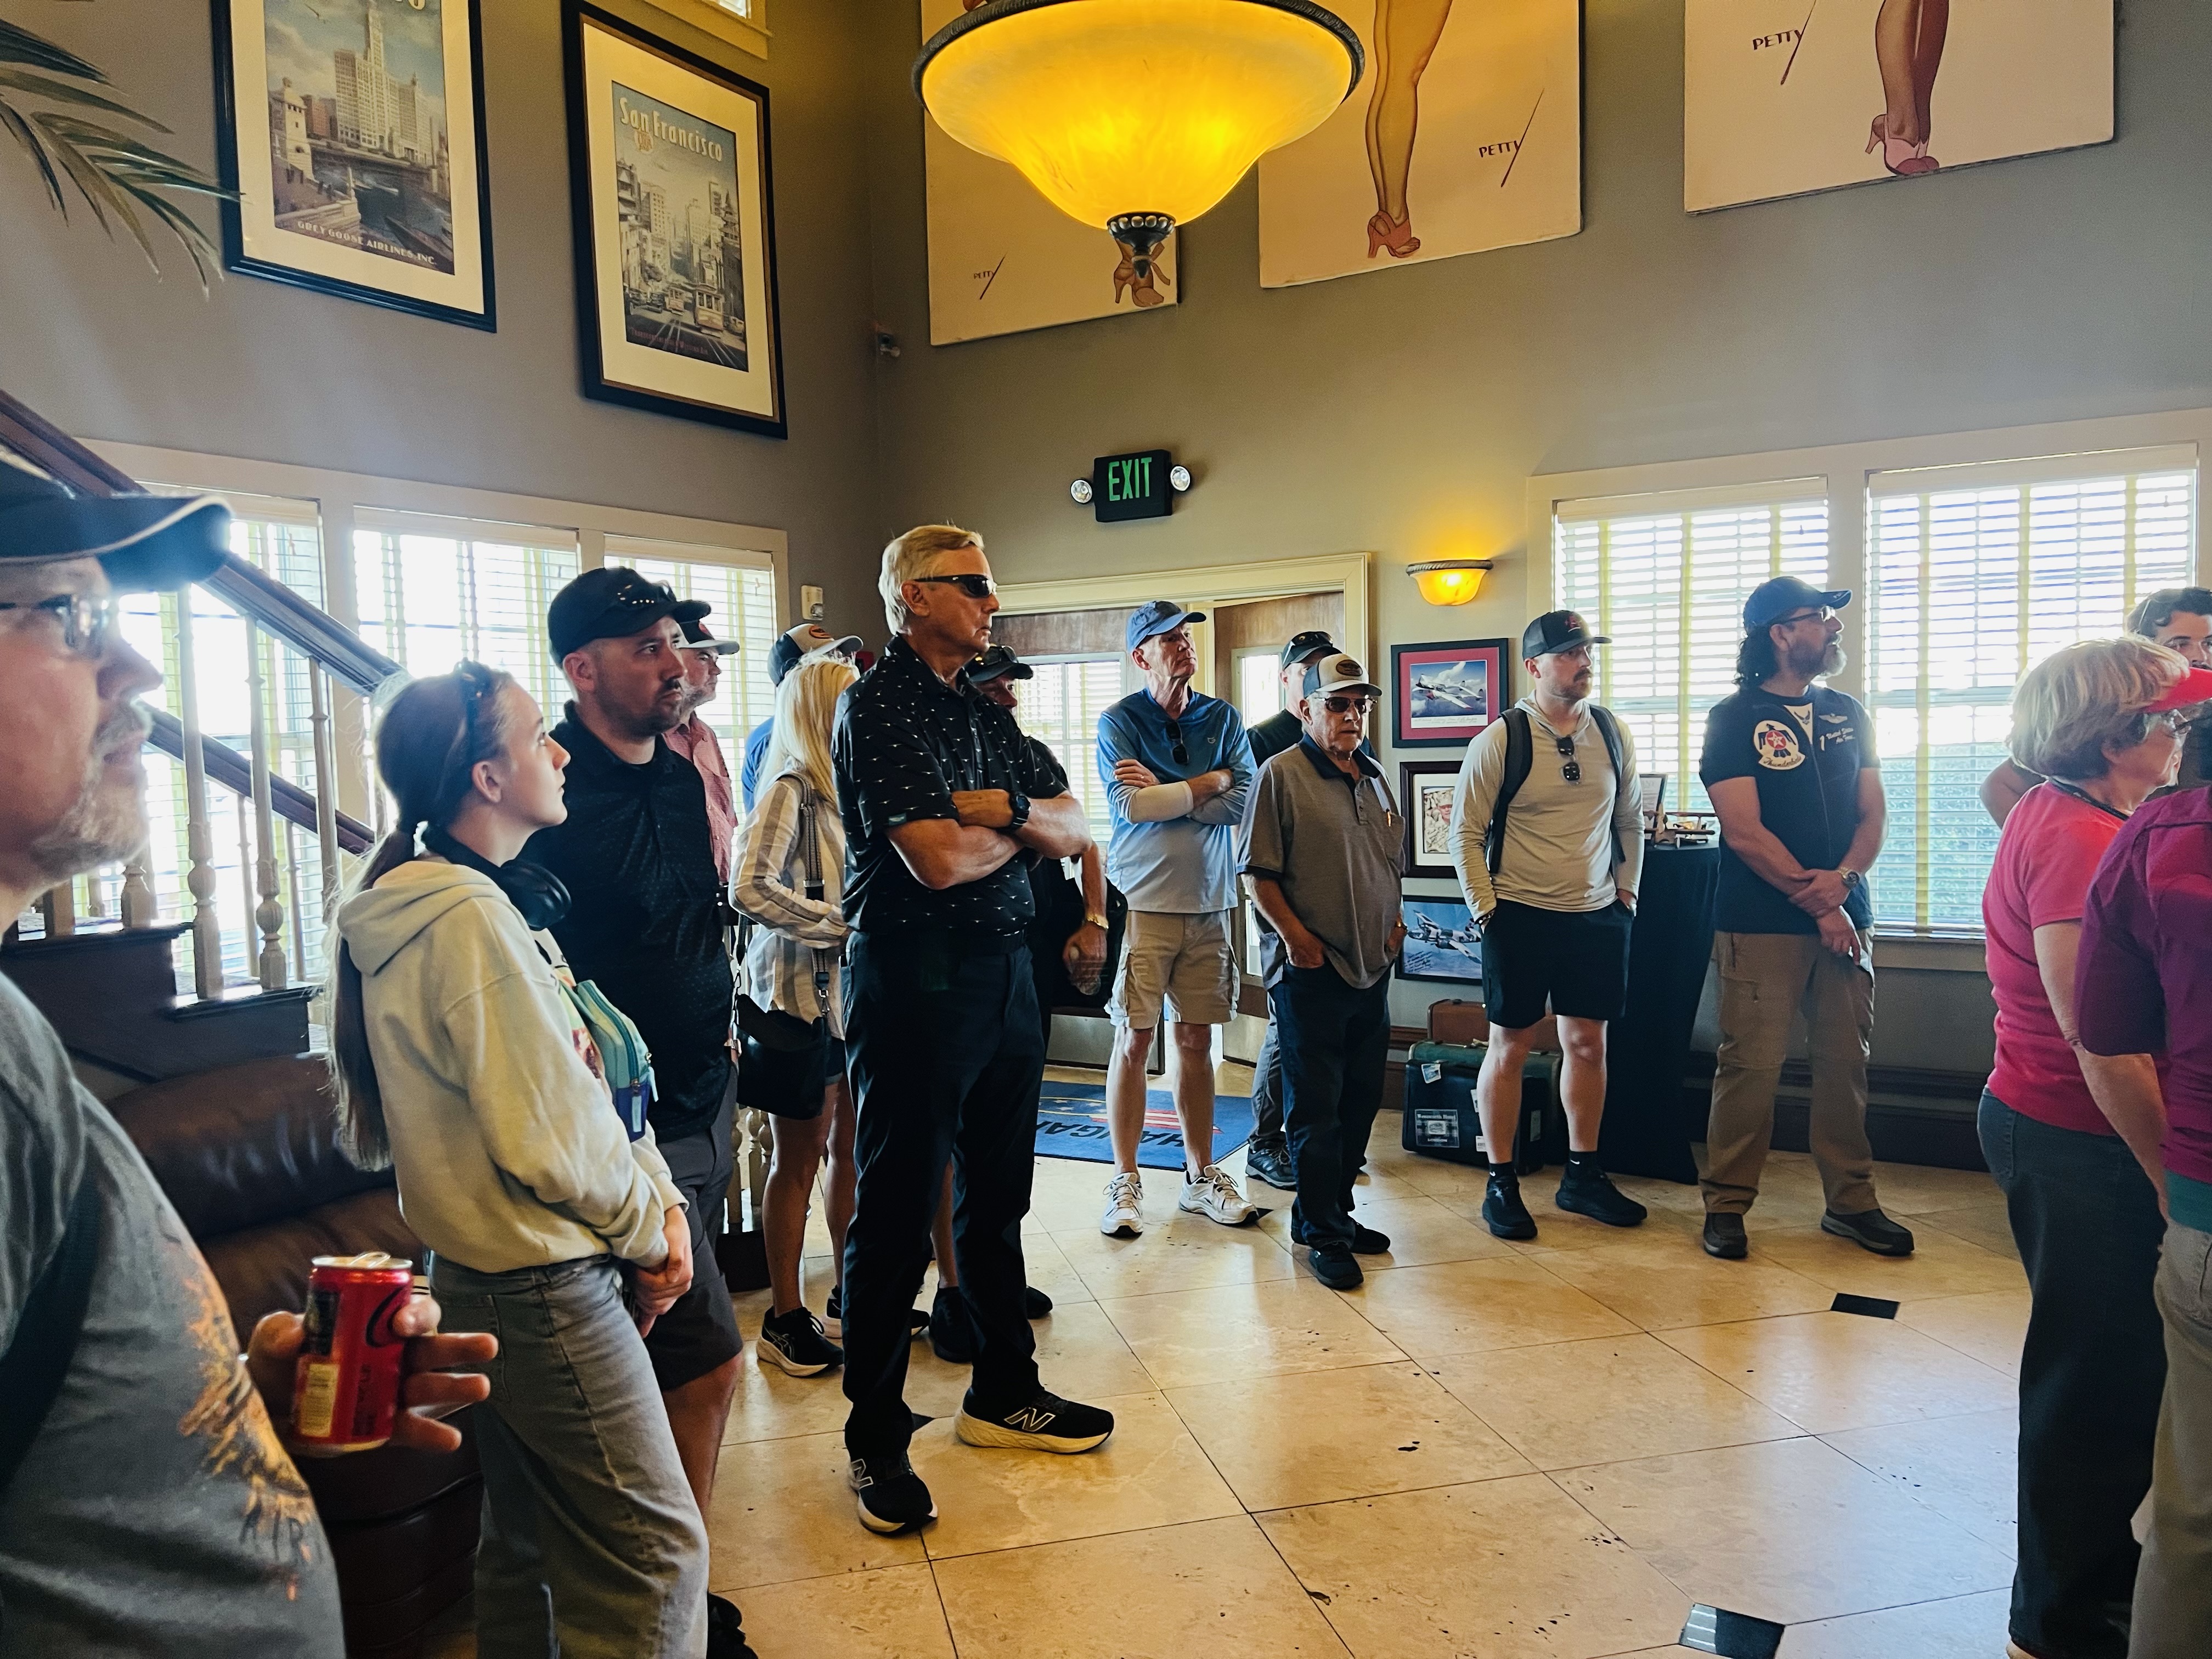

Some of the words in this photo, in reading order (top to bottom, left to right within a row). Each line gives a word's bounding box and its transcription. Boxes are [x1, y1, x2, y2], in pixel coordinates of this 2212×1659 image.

[619, 97, 650, 133] San
[653, 110, 723, 162] Francisco
[328, 229, 364, 245] GOOSE
[1108, 457, 1152, 501] EXIT
[1036, 1121, 1184, 1148] HAGA
